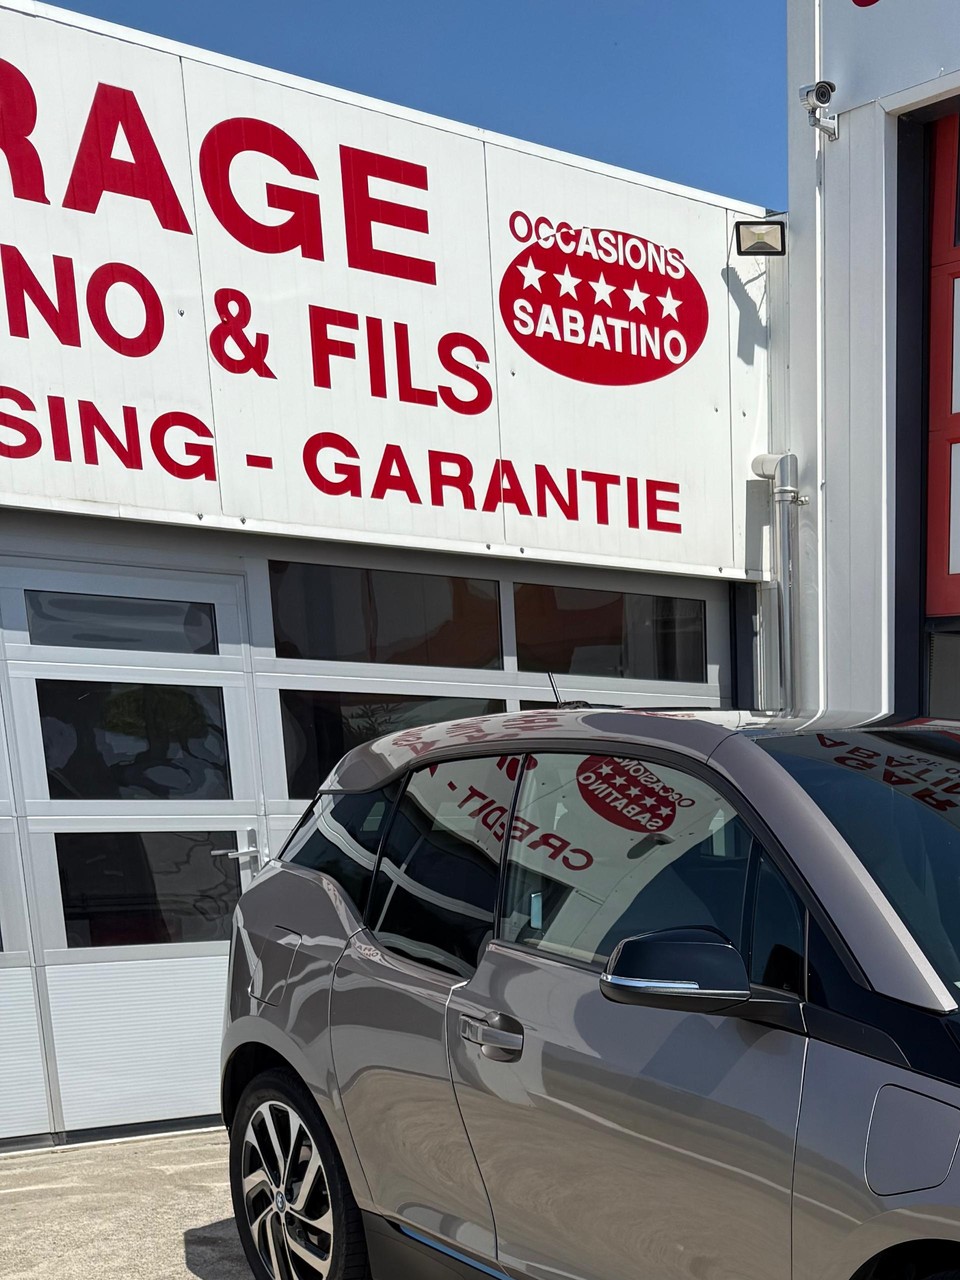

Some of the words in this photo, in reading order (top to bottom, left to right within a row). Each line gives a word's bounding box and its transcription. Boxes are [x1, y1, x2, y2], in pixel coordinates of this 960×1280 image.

[509, 210, 686, 280] OCCASIONS
[0, 243, 165, 358] NO
[209, 287, 277, 380] &
[309, 304, 493, 416] FILS
[513, 298, 687, 364] SABATINO
[0, 385, 217, 481] SING
[303, 431, 682, 534] GARANTIE
